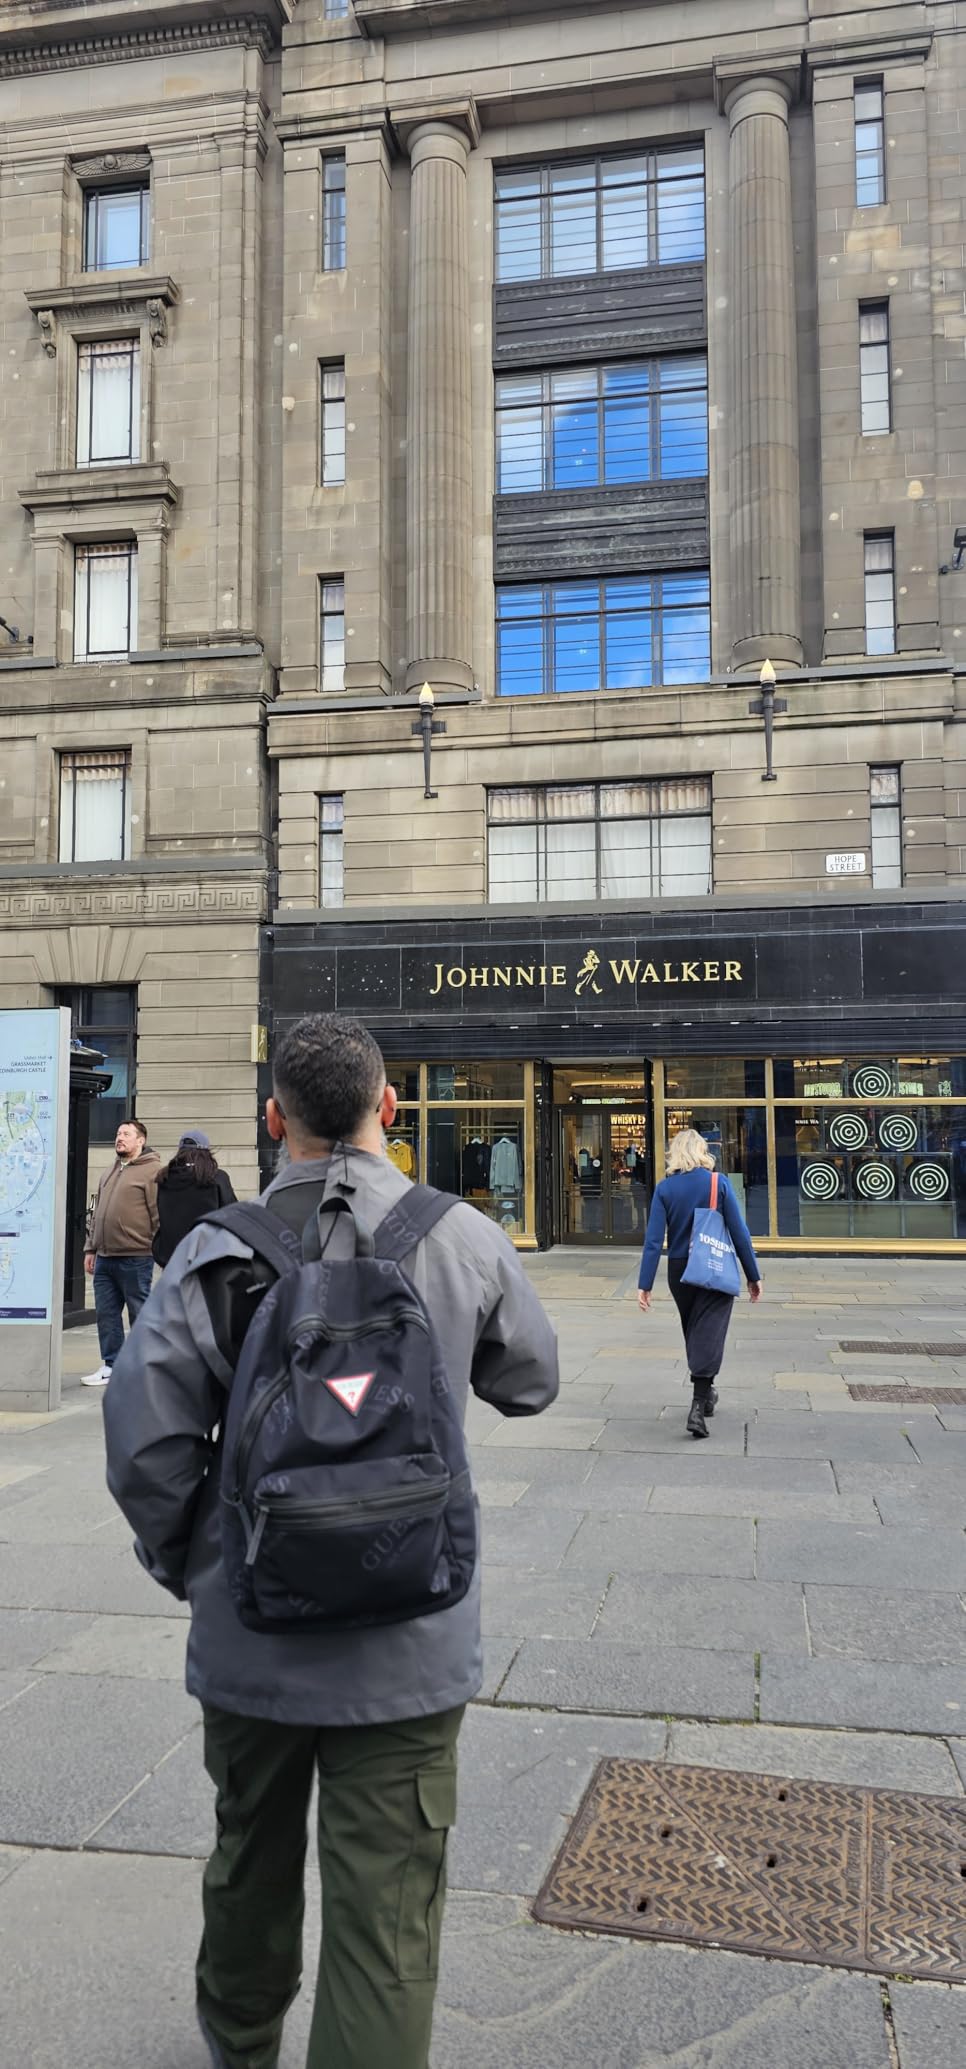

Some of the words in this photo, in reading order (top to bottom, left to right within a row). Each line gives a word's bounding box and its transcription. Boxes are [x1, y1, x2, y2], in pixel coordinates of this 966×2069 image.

[834, 855, 857, 863] HOPE
[829, 862, 862, 872] STREET
[429, 963, 567, 995] JOHNNIE
[608, 959, 743, 985] WALKER
[610, 1114, 636, 1125] WHISKY
